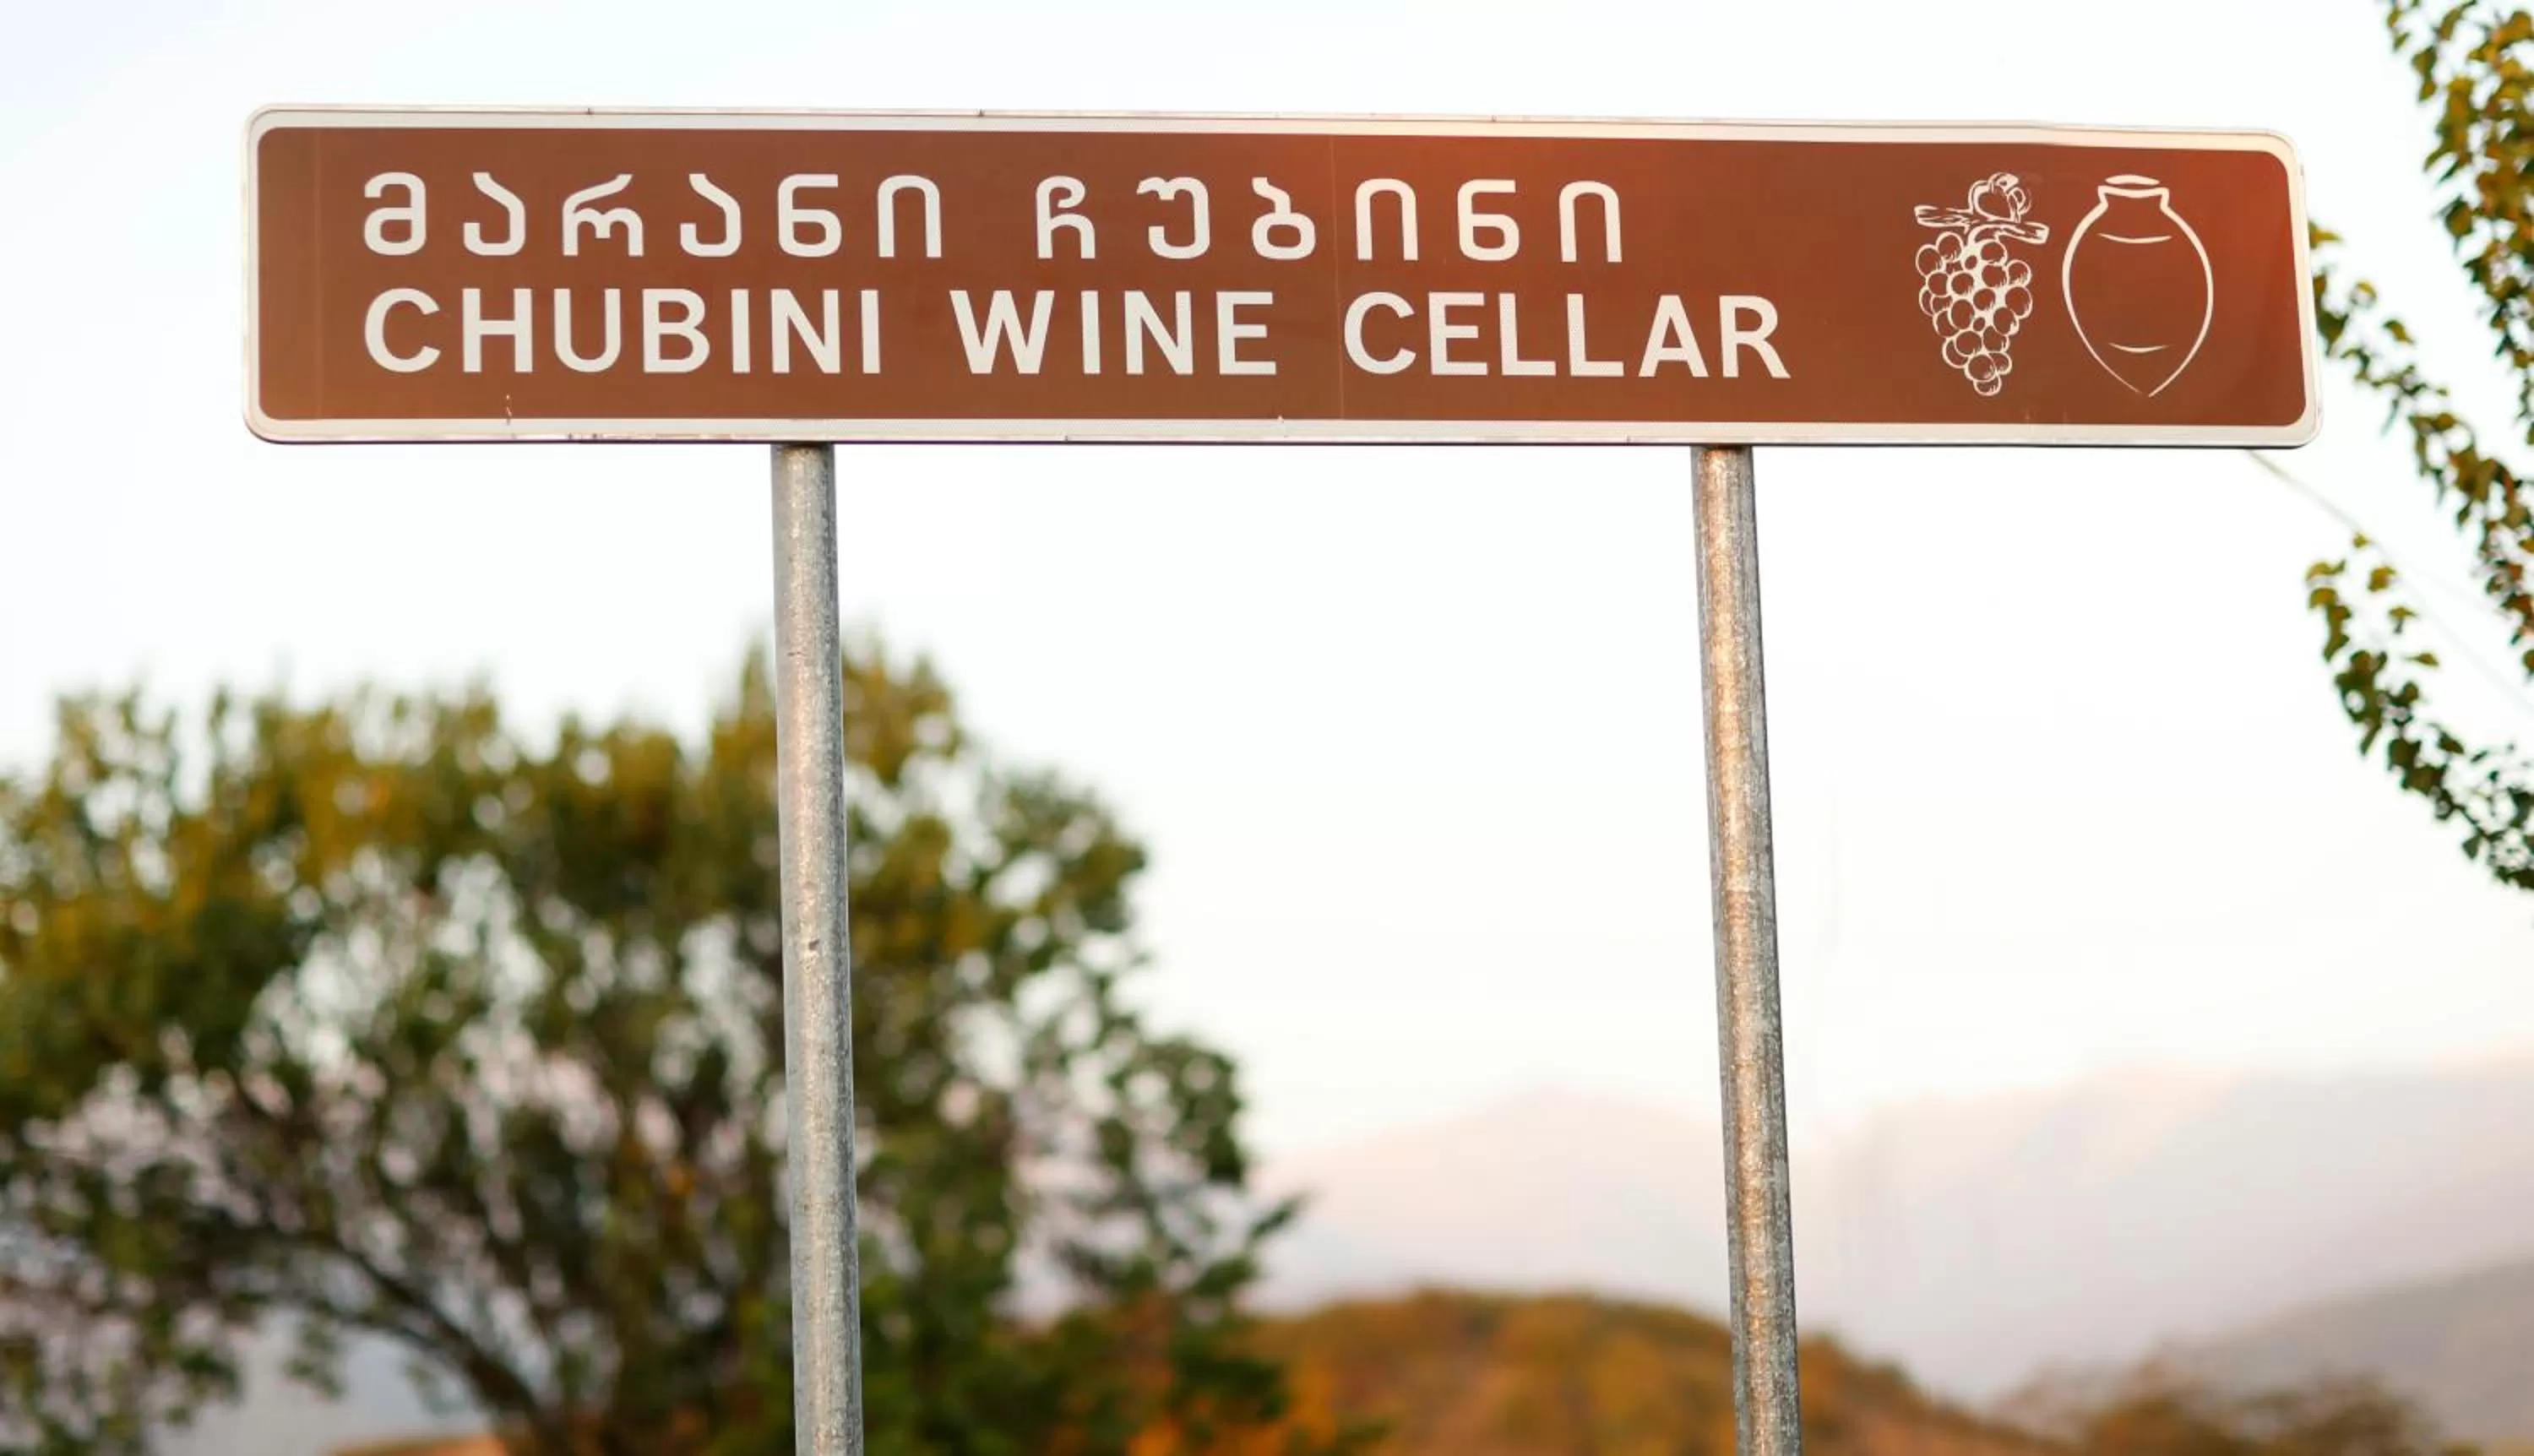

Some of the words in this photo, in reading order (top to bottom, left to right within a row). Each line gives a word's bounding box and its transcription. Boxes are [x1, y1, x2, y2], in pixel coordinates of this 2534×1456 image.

[363, 171, 943, 258] მარანი
[1036, 175, 1623, 263] ჩუბინი
[363, 288, 882, 374] CHUBINI
[949, 290, 1277, 376] WINE
[1344, 291, 1792, 378] CELLAR
